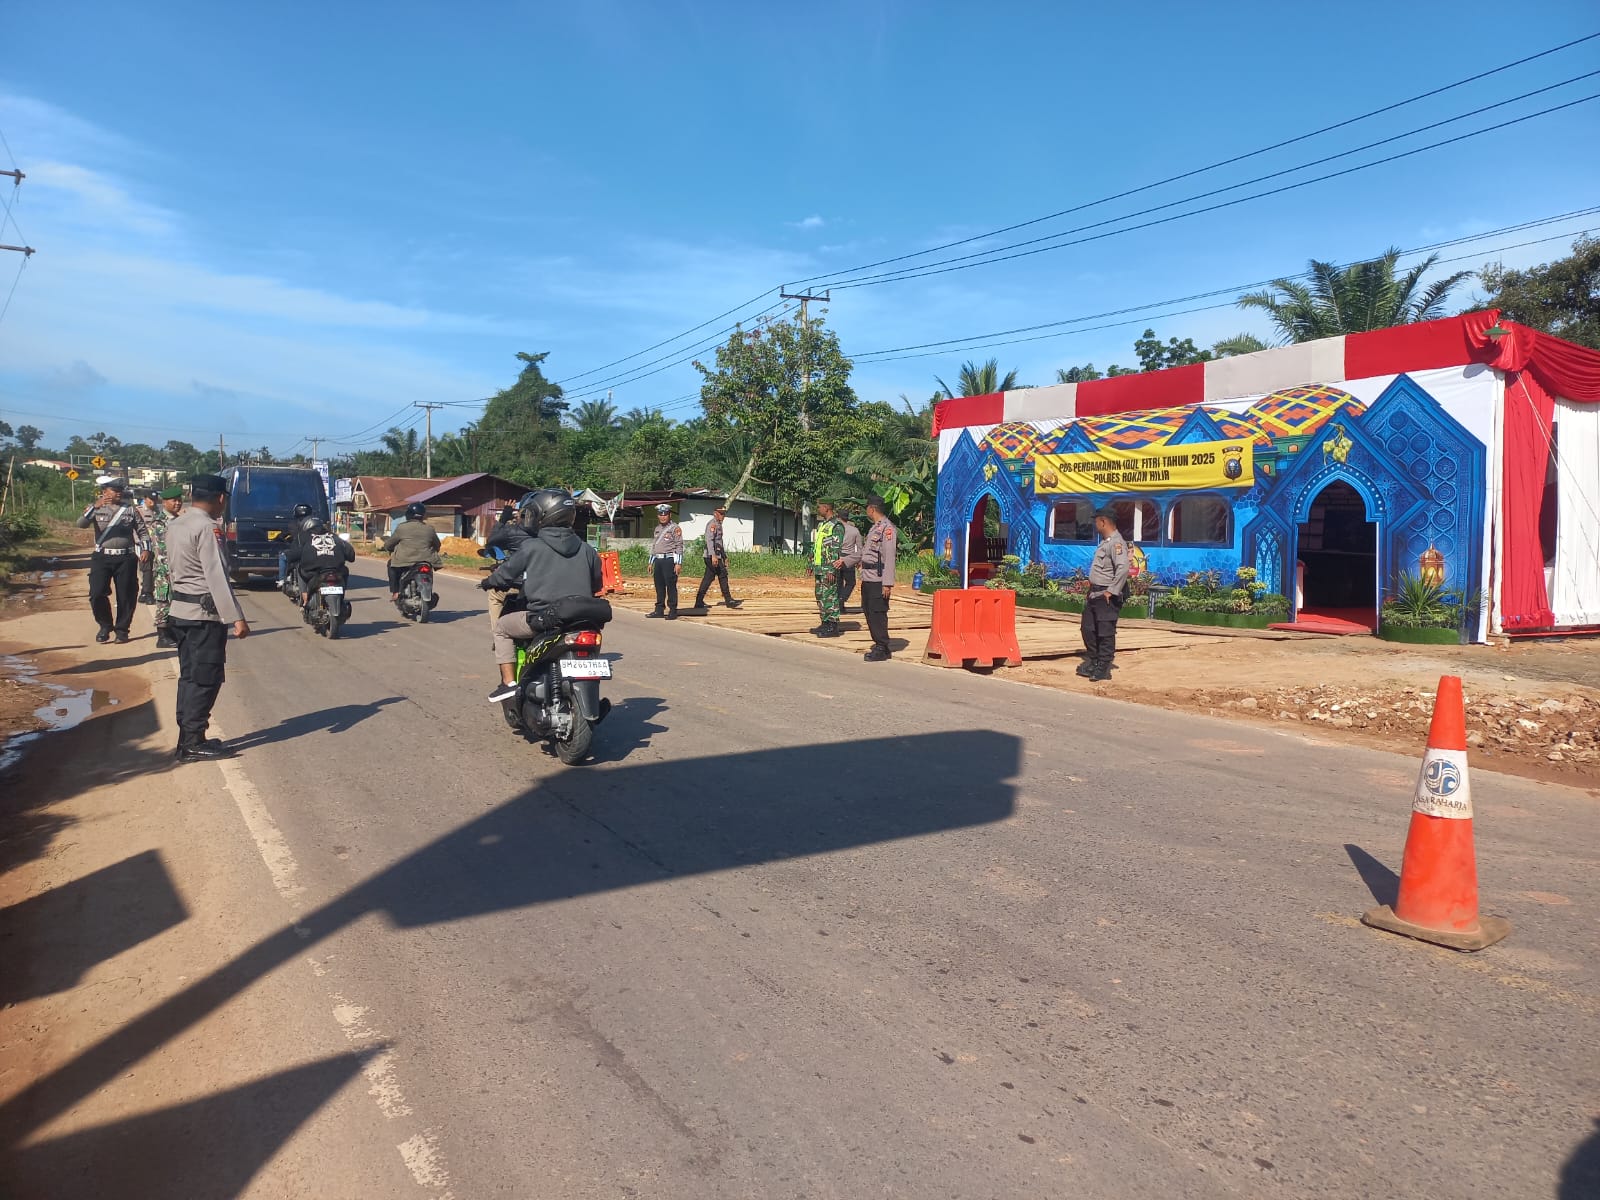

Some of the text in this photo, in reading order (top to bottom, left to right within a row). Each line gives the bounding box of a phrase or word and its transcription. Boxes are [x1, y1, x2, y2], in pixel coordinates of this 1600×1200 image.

[1073, 460, 1122, 472] PENGAMANAN
[1142, 457, 1160, 469] FITRI
[1163, 455, 1189, 467] TAHUN
[1191, 452, 1215, 466] 2025
[1093, 470, 1170, 484] POLRES ROKAN HILIR
[1430, 797, 1467, 811] RAHARJA
